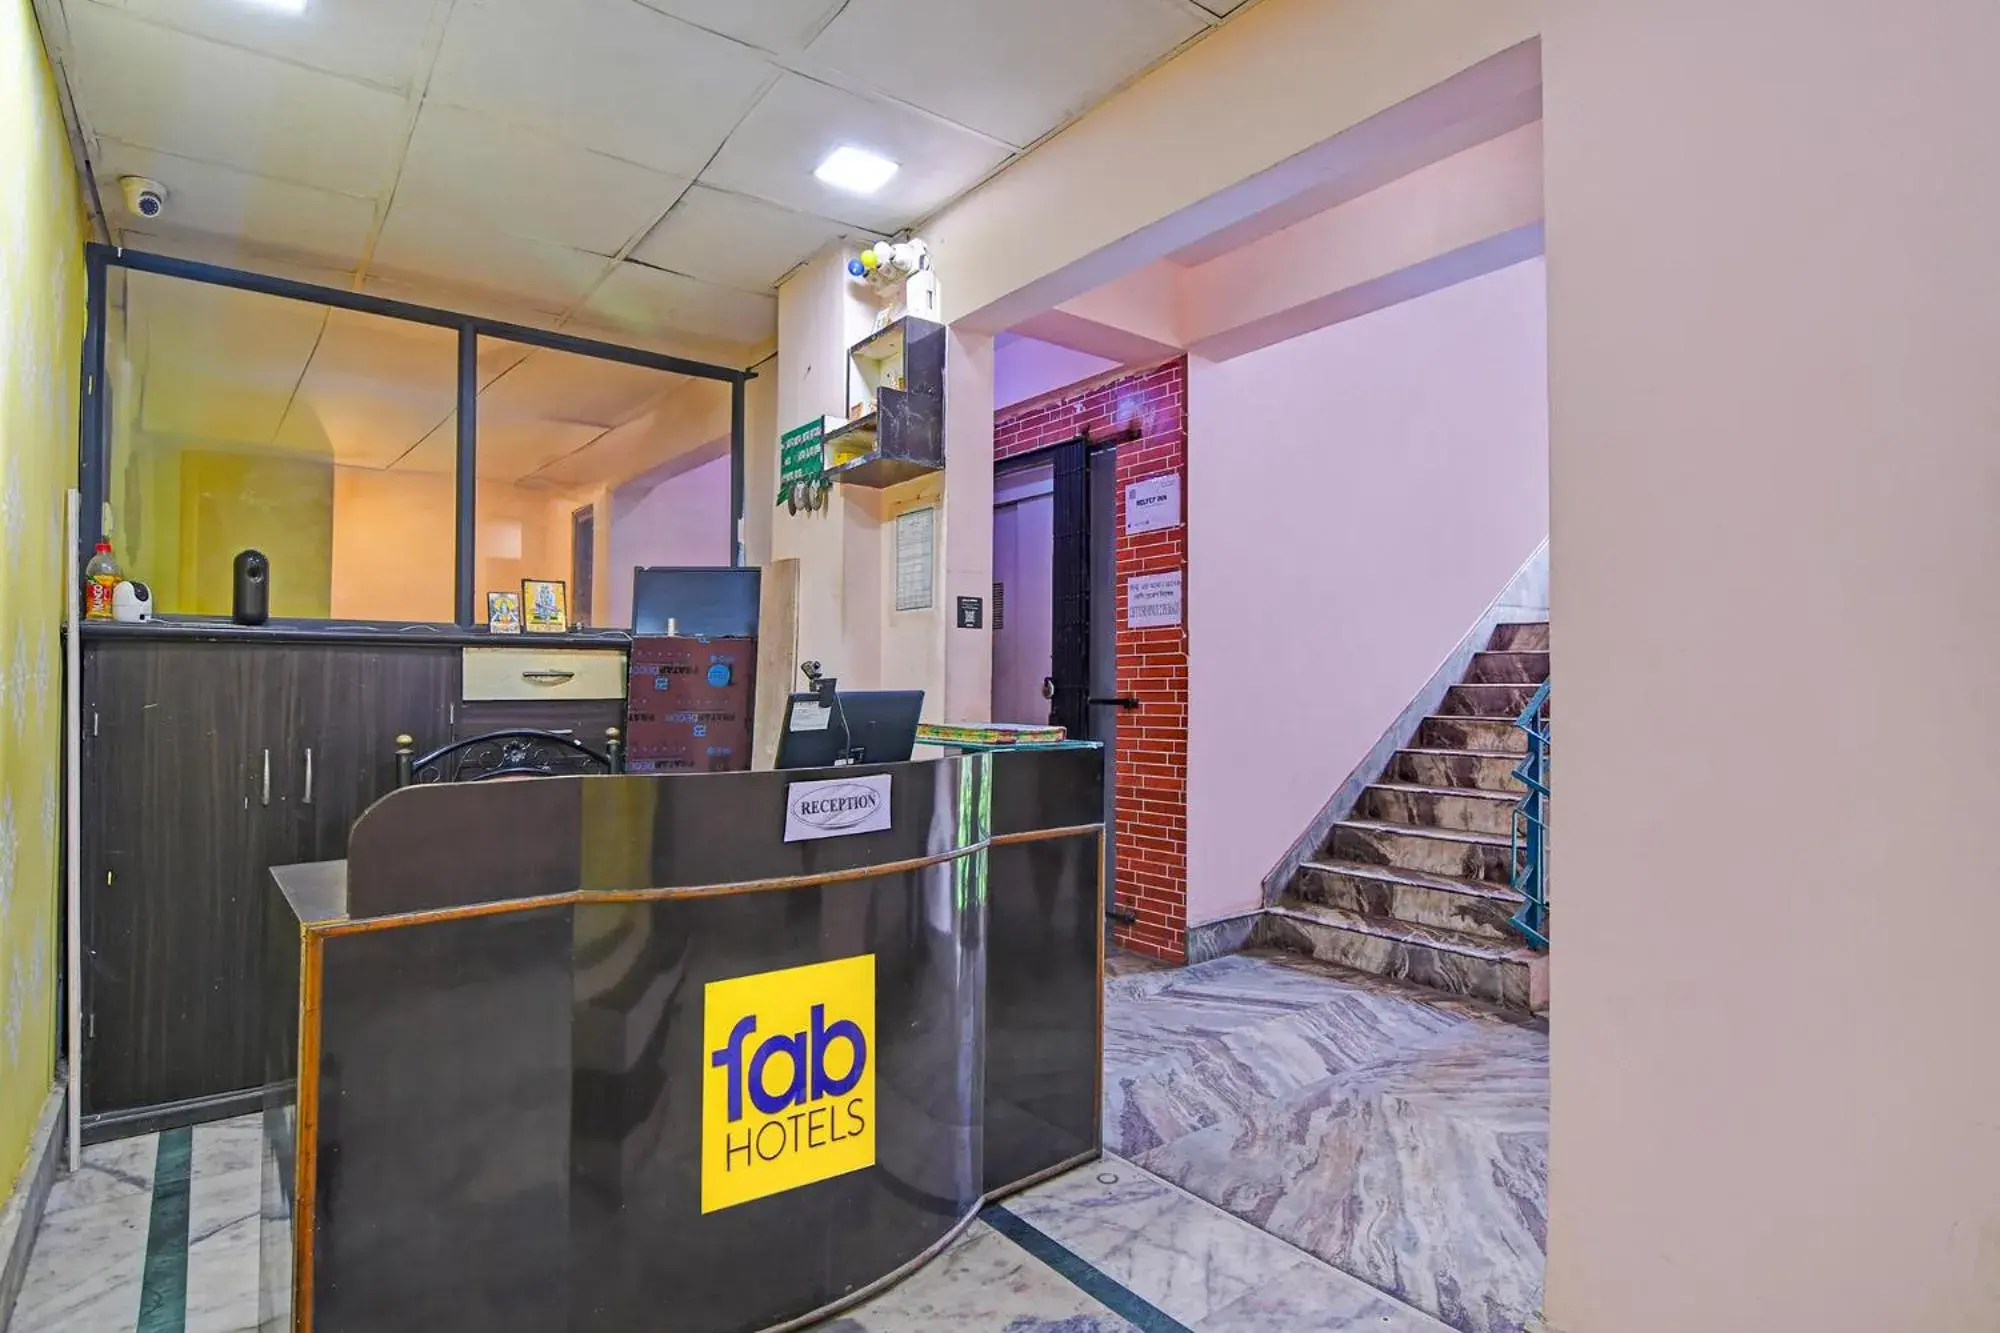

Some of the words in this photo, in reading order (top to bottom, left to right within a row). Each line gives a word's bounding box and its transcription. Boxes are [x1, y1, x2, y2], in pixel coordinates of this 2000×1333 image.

[801, 794, 876, 815] RECEPTION
[712, 1003, 867, 1123] fab
[726, 1098, 866, 1172] HOTELS
